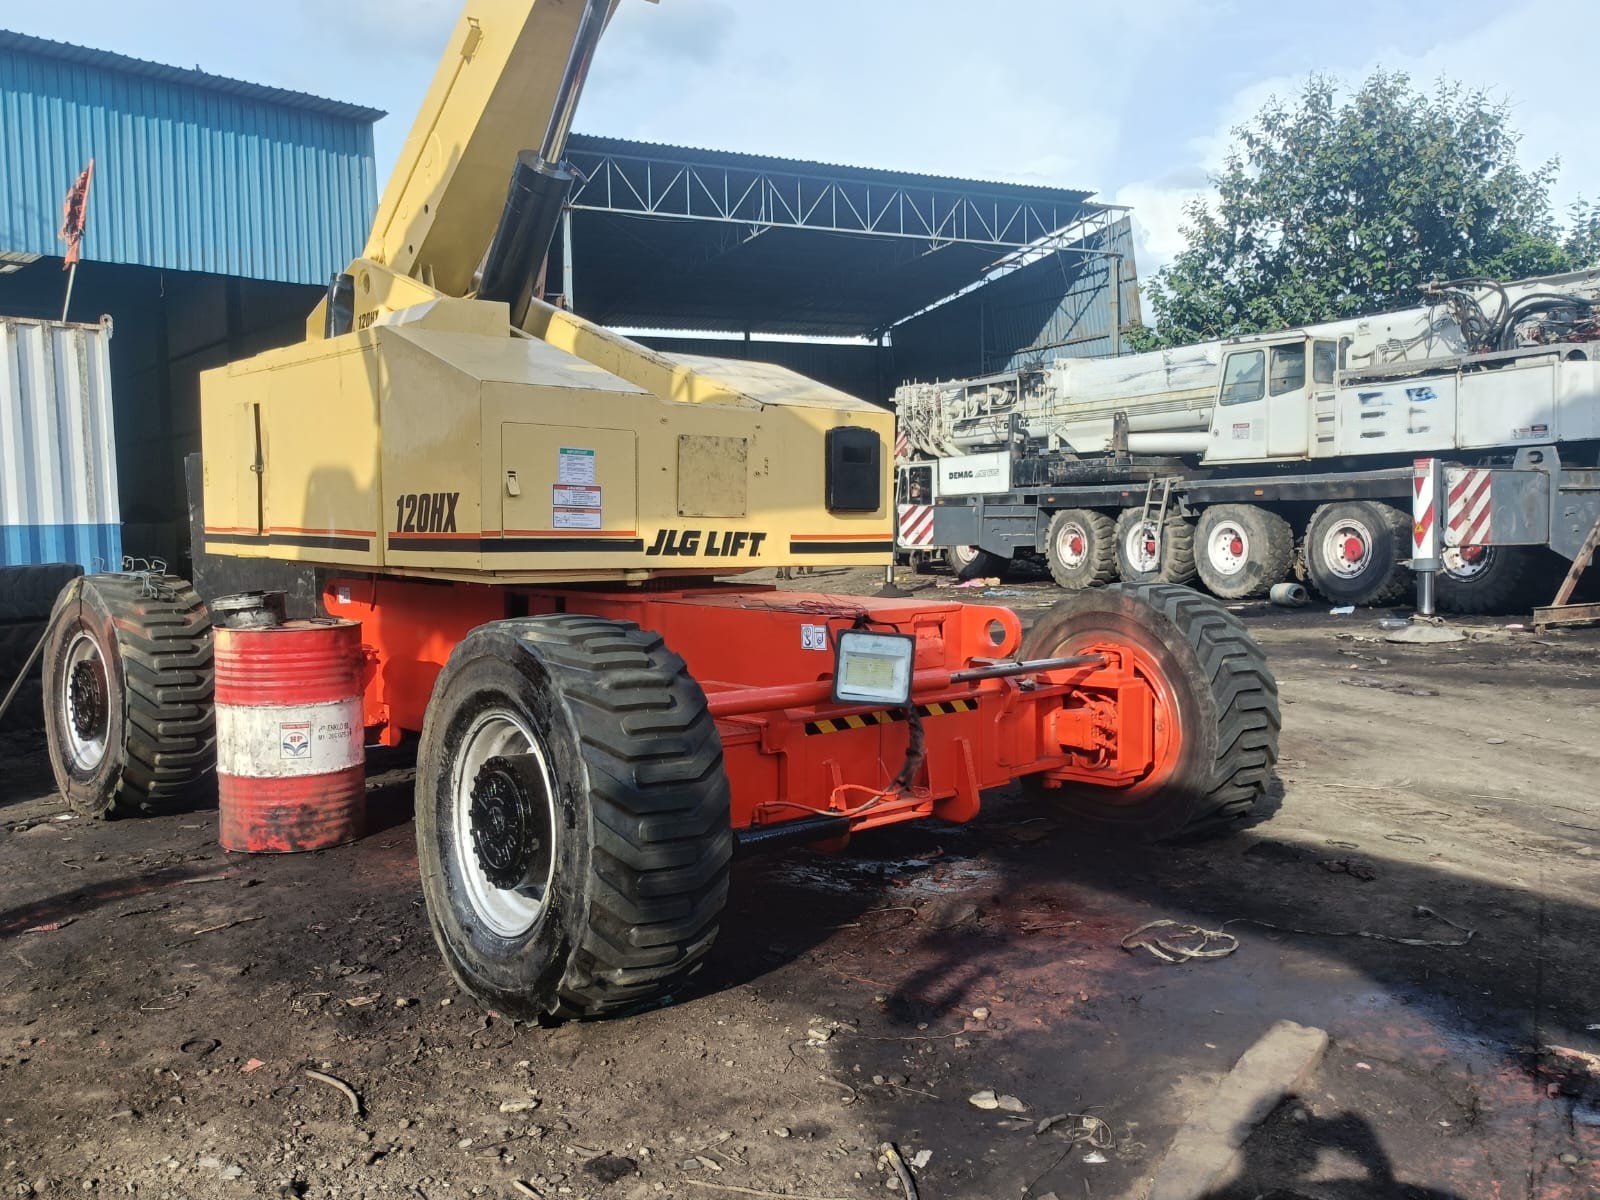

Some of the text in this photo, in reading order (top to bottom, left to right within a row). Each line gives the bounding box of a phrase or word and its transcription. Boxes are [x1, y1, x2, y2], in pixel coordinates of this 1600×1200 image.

[1004, 419, 1030, 429] DAG
[949, 471, 973, 479] DEMAG
[397, 492, 460, 532] 120HX
[646, 529, 701, 556] JLG
